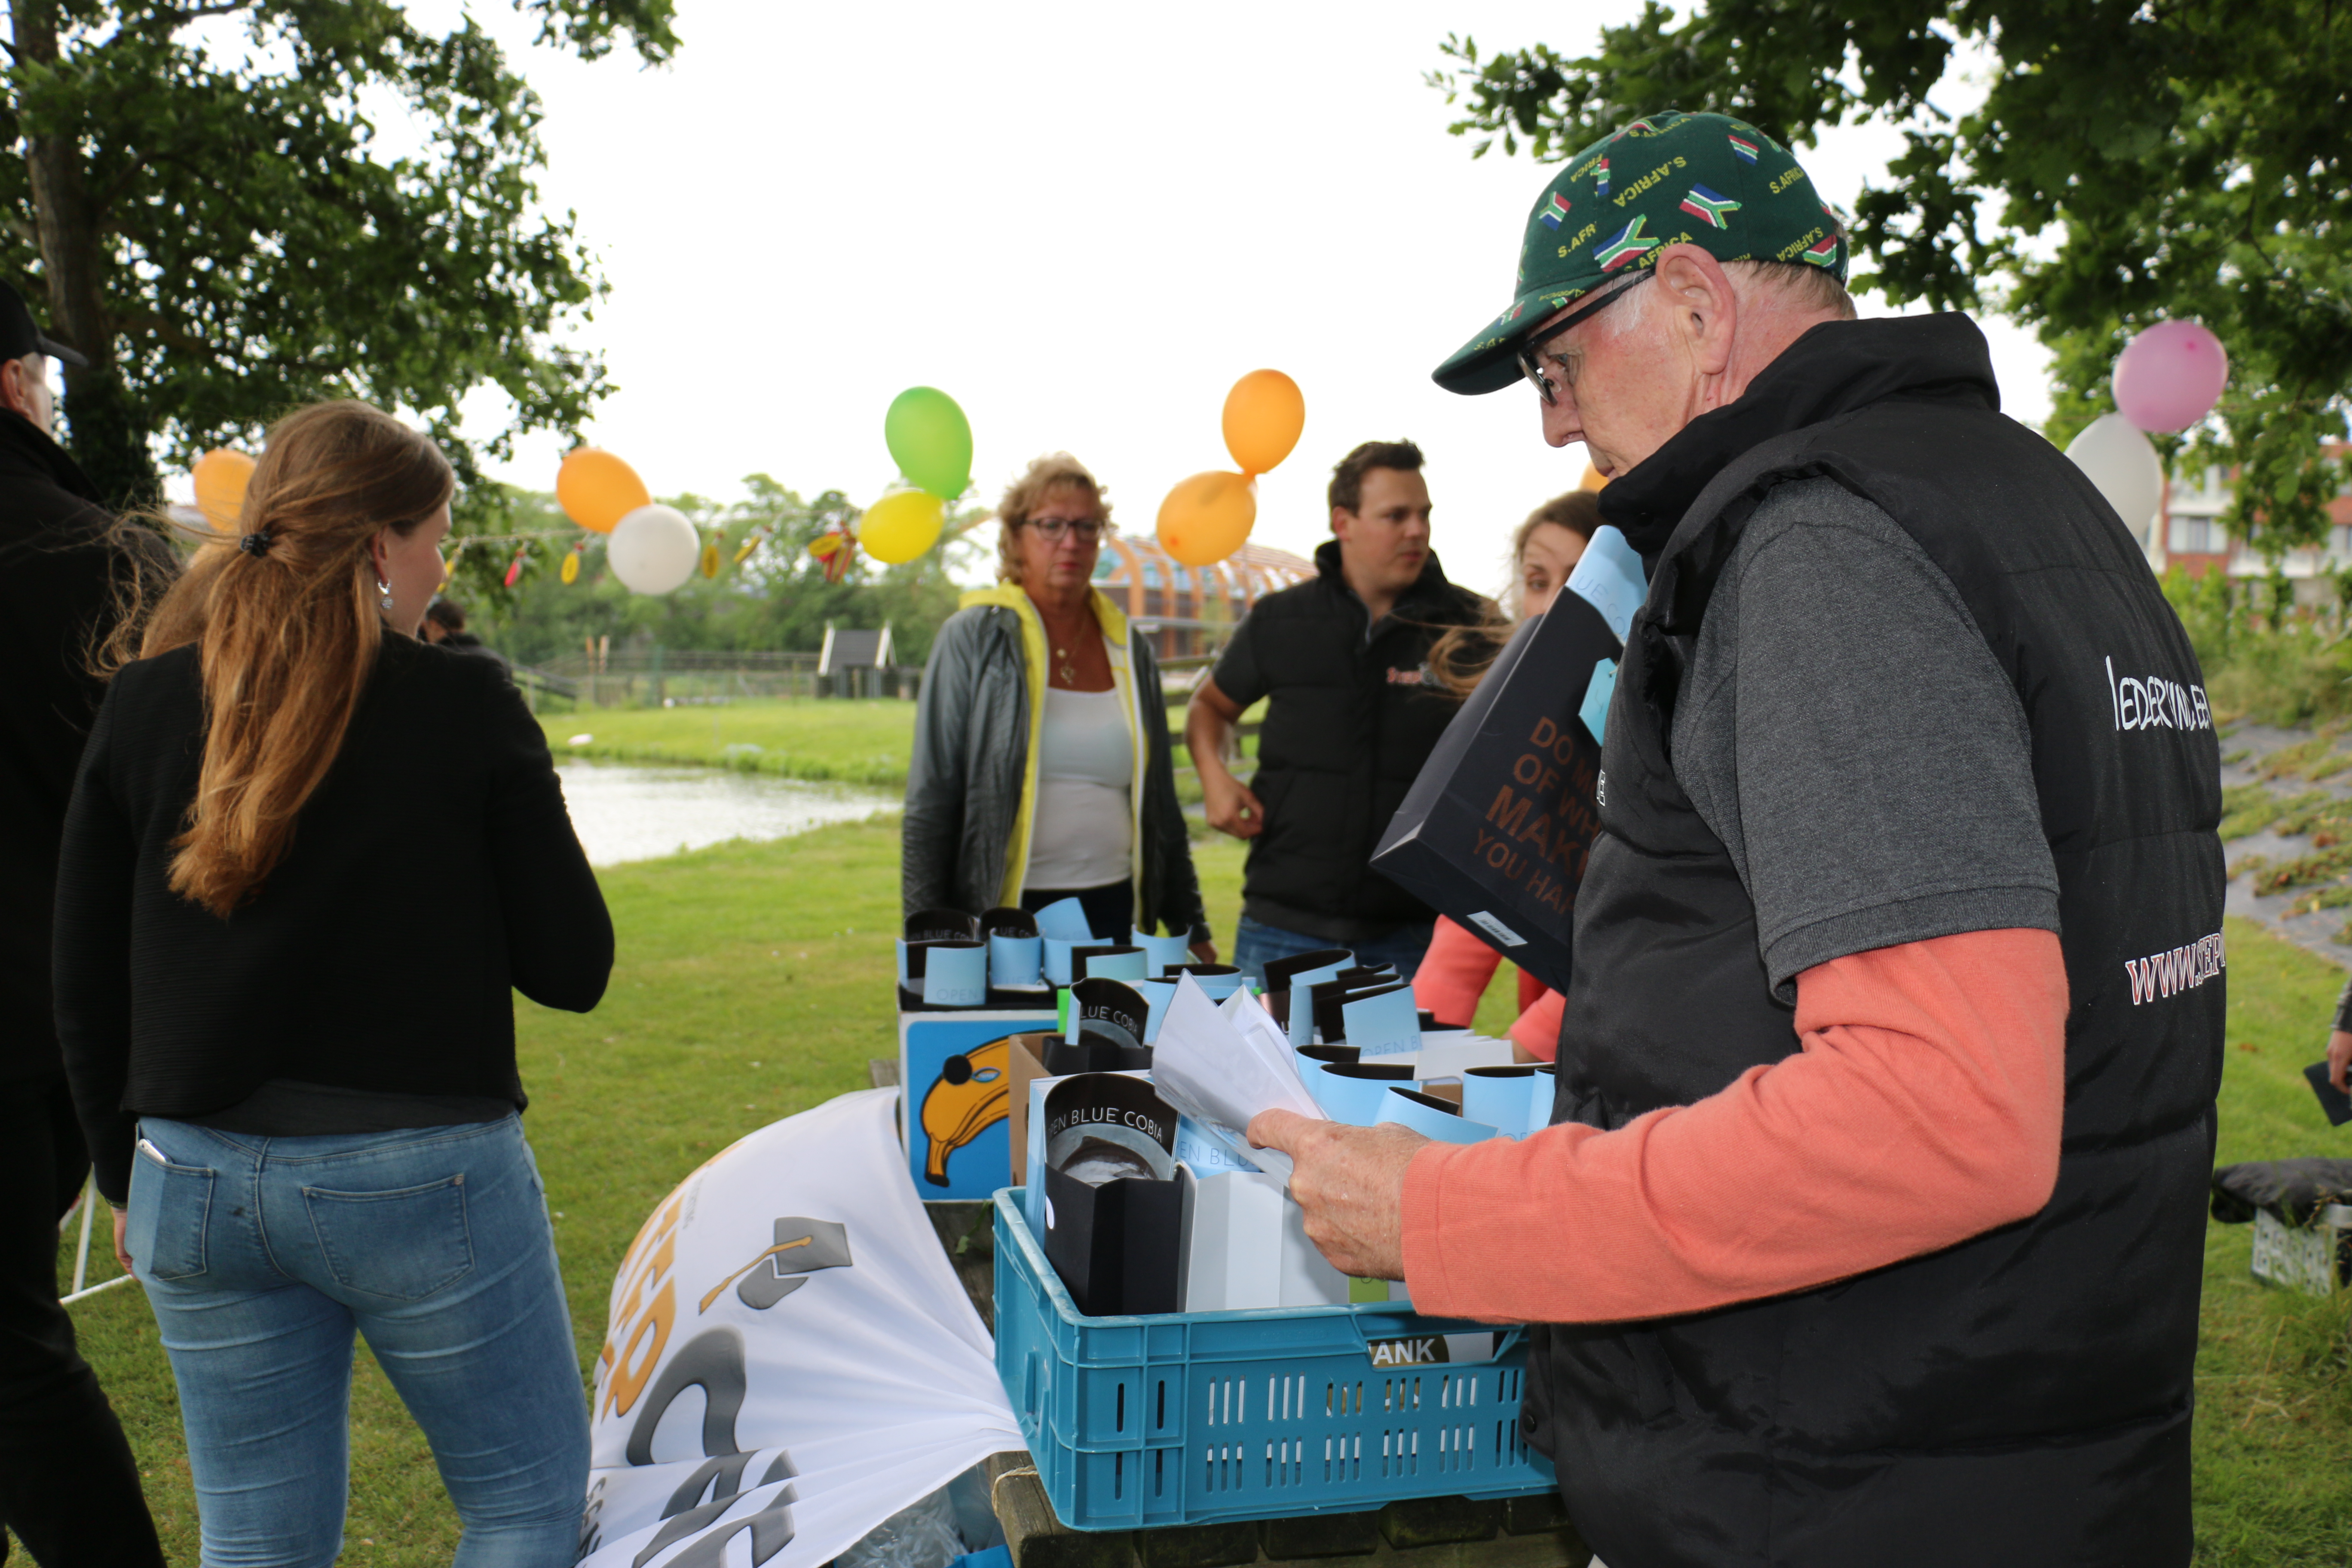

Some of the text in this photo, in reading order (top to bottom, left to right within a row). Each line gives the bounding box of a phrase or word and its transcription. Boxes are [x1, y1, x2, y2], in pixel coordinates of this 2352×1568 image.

[1613, 156, 1687, 207] S.AFRICA
[1776, 227, 1824, 262] S.AFRICA
[1529, 716, 1574, 766] DO
[1513, 753, 1561, 794] OF
[1473, 827, 1528, 880] YOU
[1072, 1107, 1119, 1124] BLUE
[1124, 1111, 1162, 1144] COBIA
[1369, 1338, 1436, 1366] ANK
